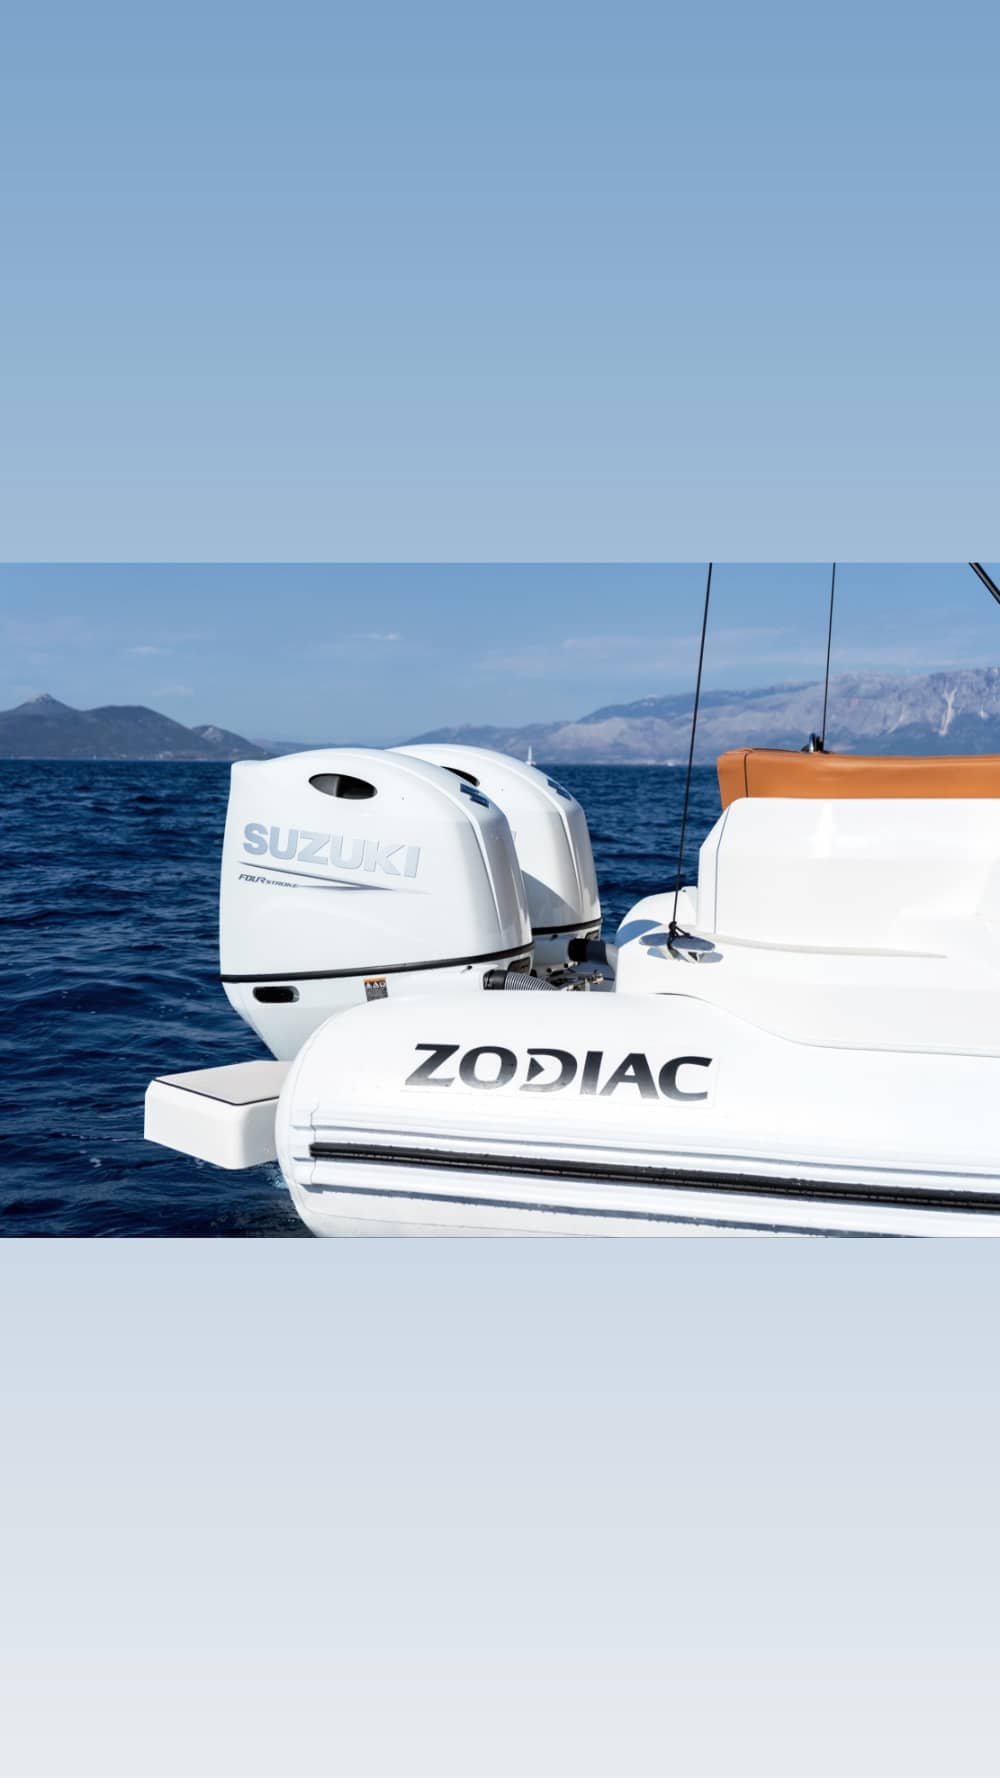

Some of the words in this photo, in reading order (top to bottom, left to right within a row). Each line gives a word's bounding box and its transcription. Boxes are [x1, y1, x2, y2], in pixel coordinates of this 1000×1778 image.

[243, 822, 421, 878] SUZUKI
[238, 873, 266, 884] FOUR
[405, 1043, 713, 1102] ZODIAC
